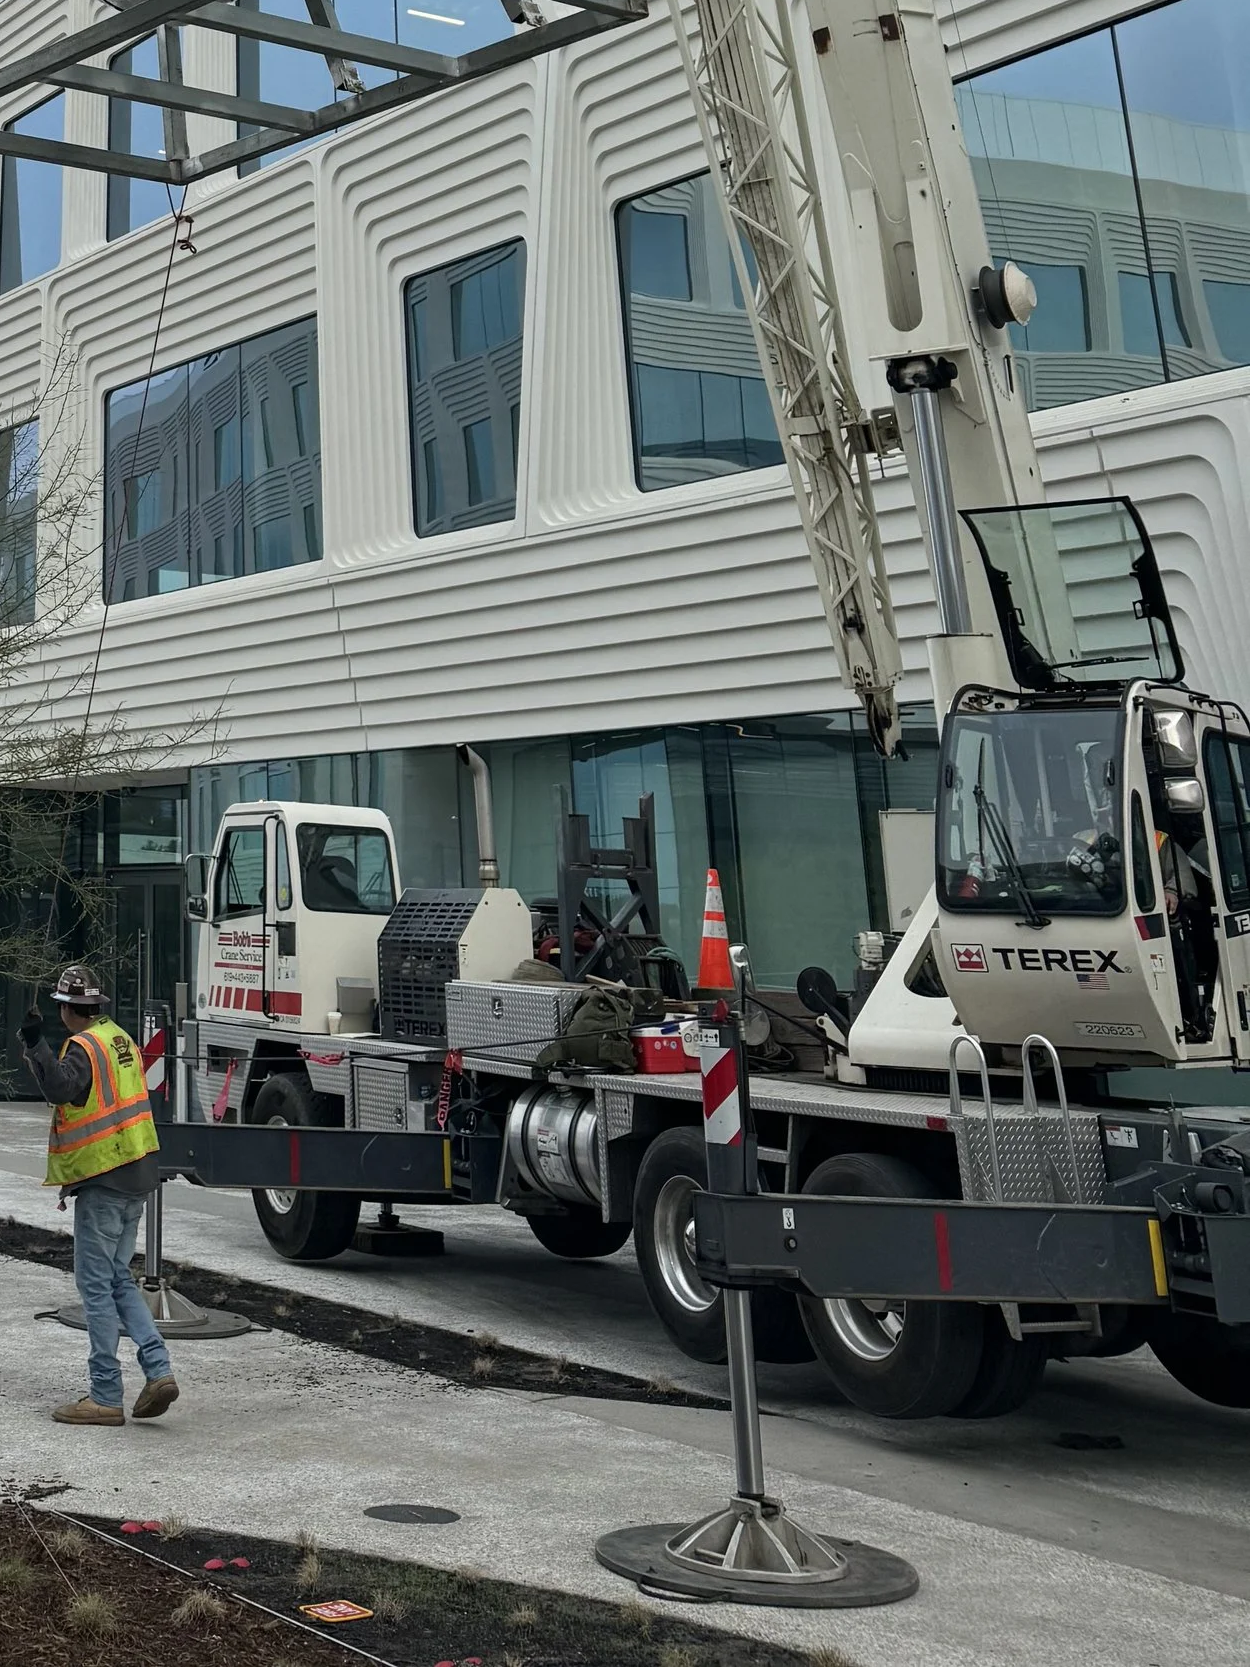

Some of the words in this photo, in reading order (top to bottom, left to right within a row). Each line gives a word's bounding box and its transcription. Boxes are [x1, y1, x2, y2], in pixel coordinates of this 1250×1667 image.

[232, 930, 252, 948] Bob's
[220, 947, 239, 961] Crane
[239, 948, 263, 962] Service
[991, 947, 1126, 974] TEREX
[405, 1018, 448, 1037] TEREX
[437, 1065, 452, 1122] DANGER
